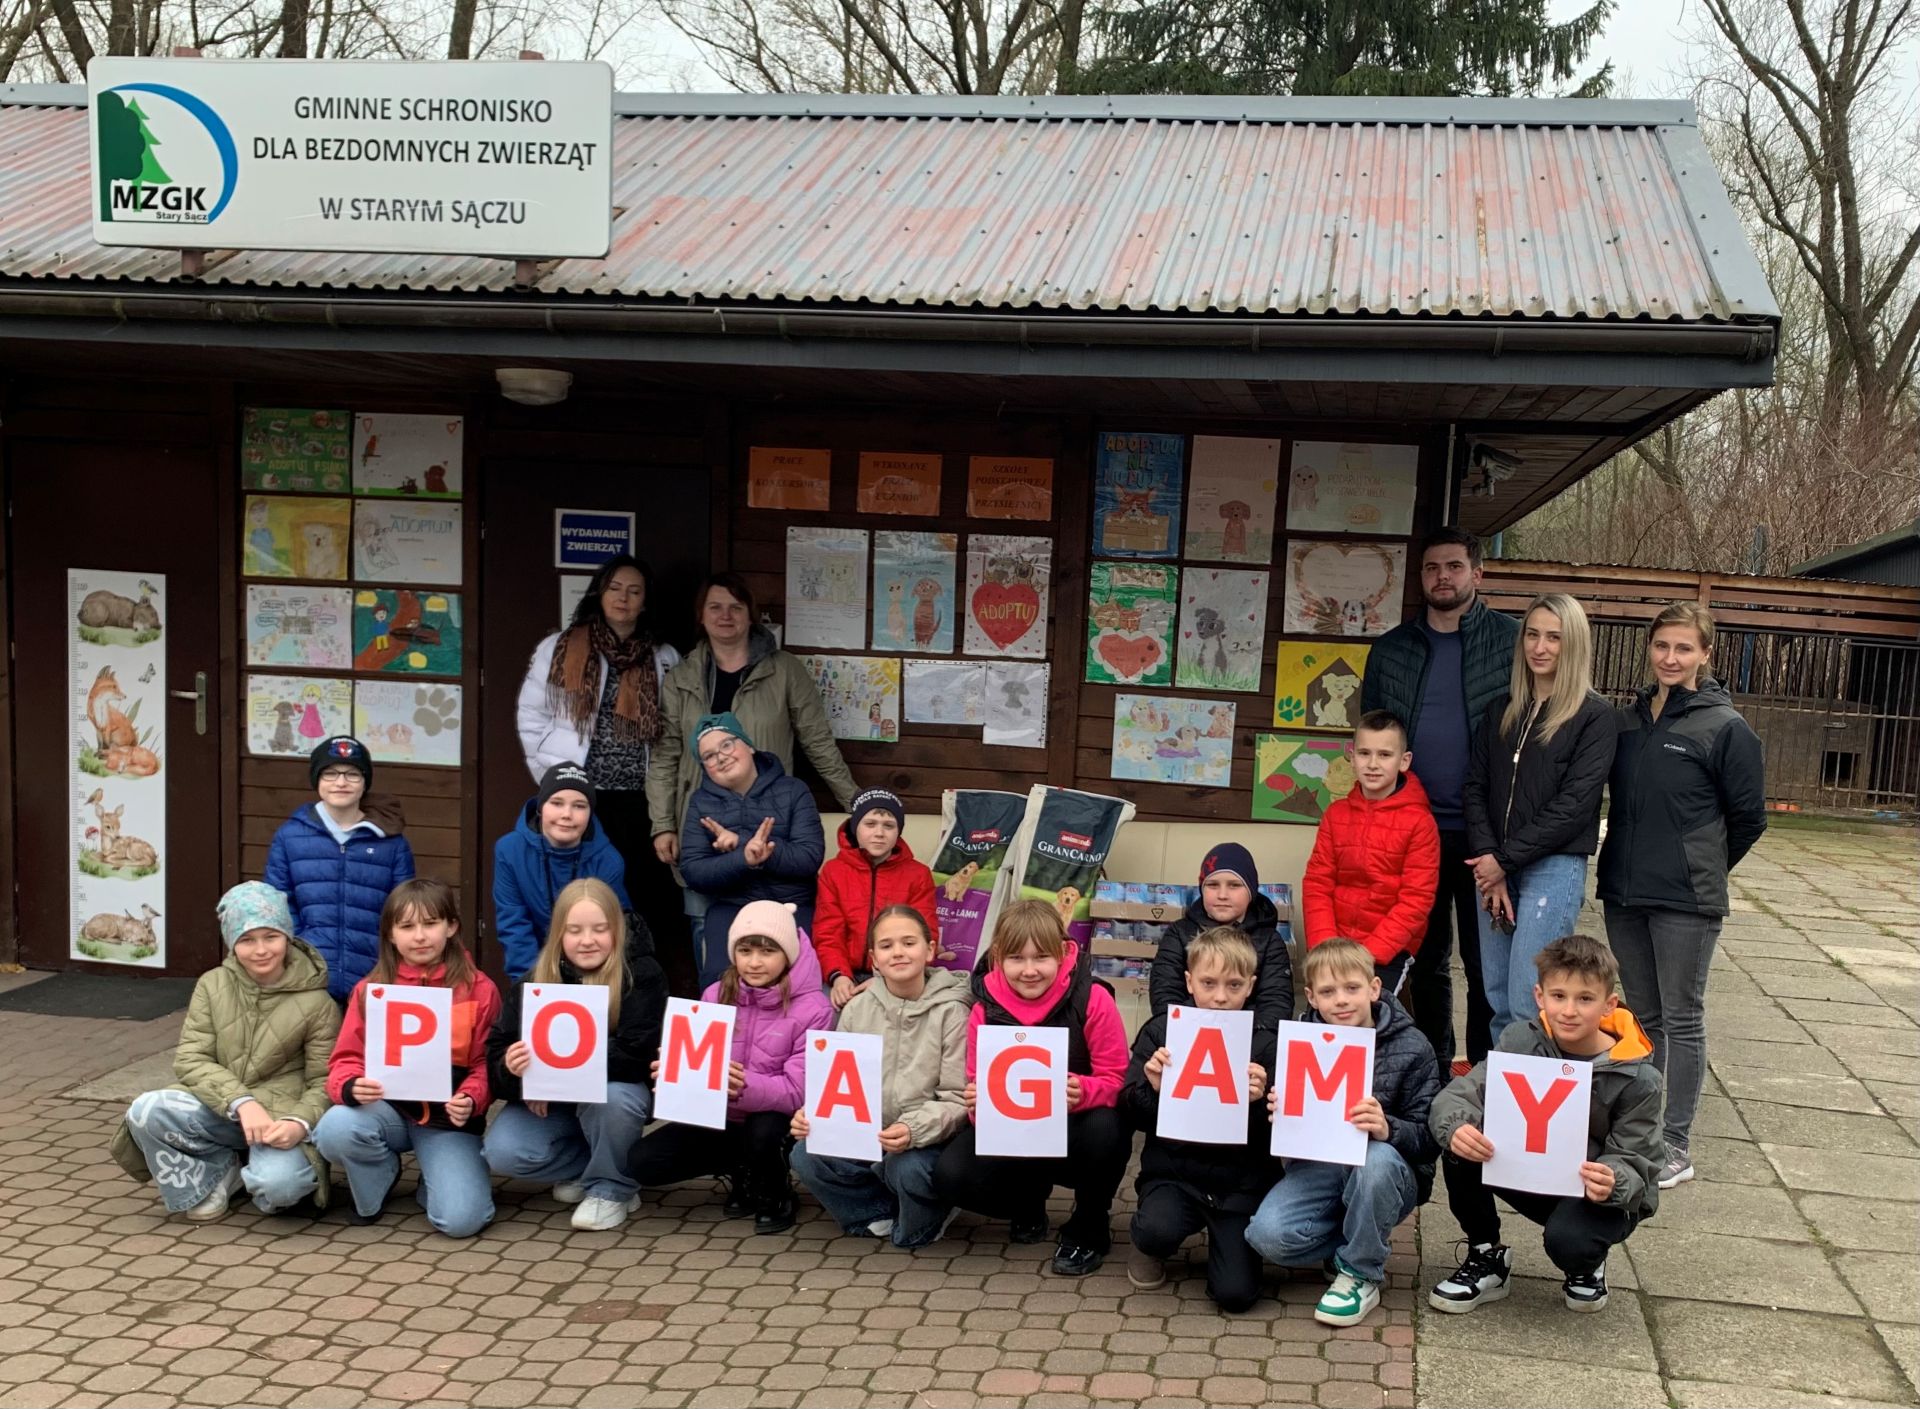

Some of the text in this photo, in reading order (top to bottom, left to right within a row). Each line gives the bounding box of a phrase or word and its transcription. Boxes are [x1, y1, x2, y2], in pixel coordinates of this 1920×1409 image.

[295, 97, 552, 123] GMINNE SCHRONISKO
[253, 137, 597, 172] DLA BEZDOMNYCH ZWIERZĄT
[113, 185, 207, 211] MZGK
[156, 211, 181, 222] Stary
[320, 197, 527, 229] W STARYM SĄCZU
[773, 455, 805, 464] PRACE
[873, 460, 928, 471] WYKONANE
[992, 464, 1029, 474] SZKOŁY
[562, 527, 629, 539] WYDAWANIE
[567, 541, 623, 554] ZWIERZĄT
[979, 602, 1038, 627] ADOPTUJ
[556, 772, 590, 784] adidas
[956, 908, 979, 919] LAMM
[386, 1002, 436, 1067] P
[532, 1001, 596, 1069] O
[665, 1015, 727, 1091] M
[1172, 1028, 1239, 1105] A
[815, 1050, 872, 1123] A
[987, 1045, 1052, 1121] G
[1283, 1040, 1366, 1121] M
[1503, 1072, 1576, 1154] Y
